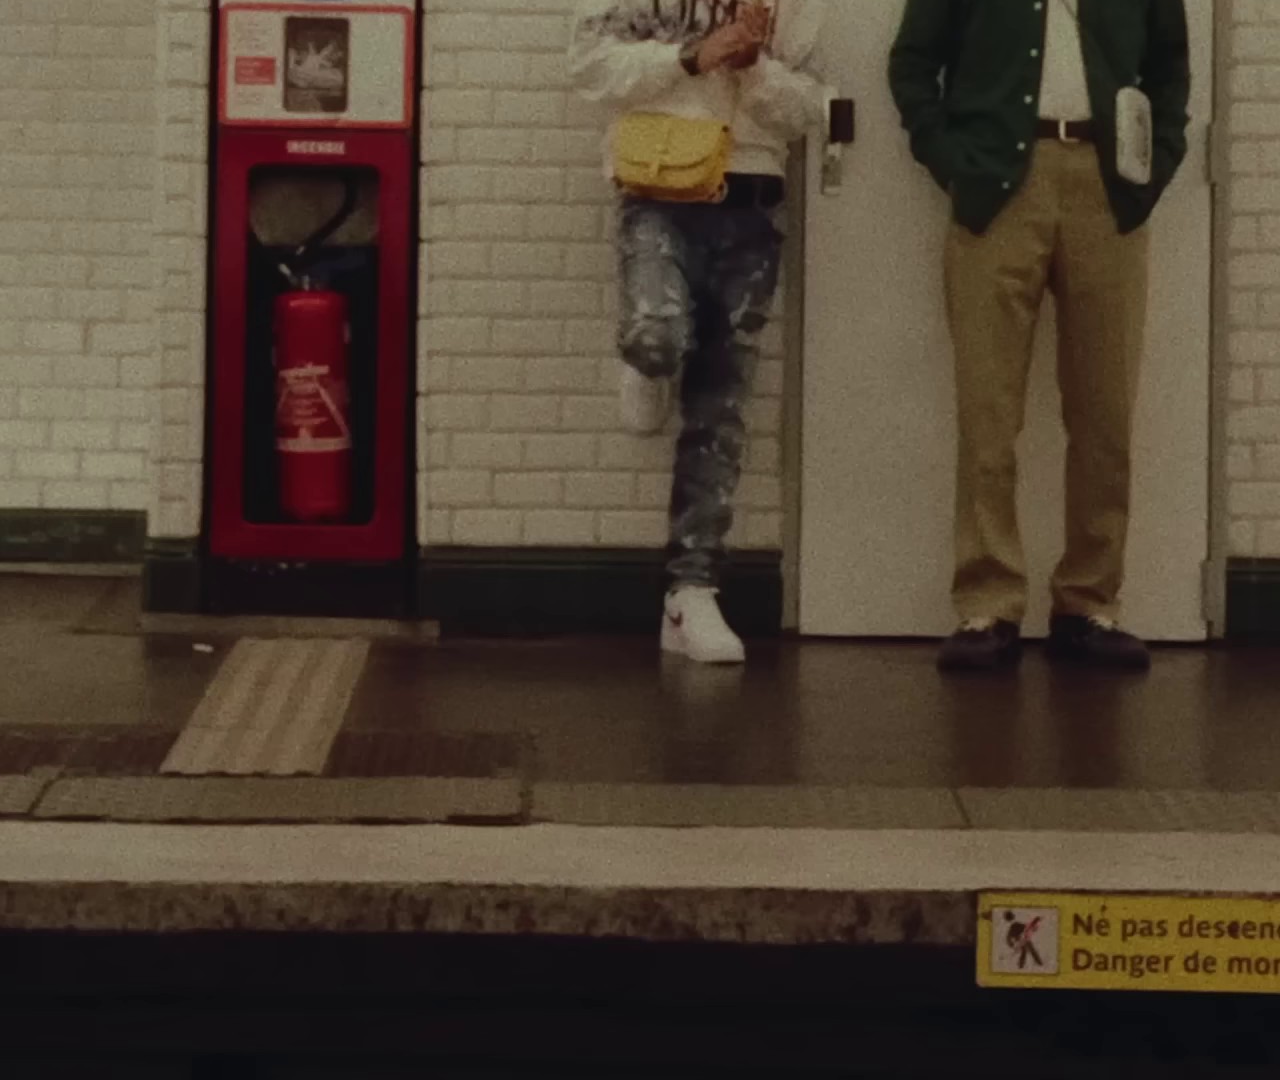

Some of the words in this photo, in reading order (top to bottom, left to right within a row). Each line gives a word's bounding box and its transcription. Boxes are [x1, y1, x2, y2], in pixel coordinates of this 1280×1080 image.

[1121, 919, 1169, 943] pas
[1072, 947, 1175, 979] Danger
[1183, 950, 1218, 974] de
